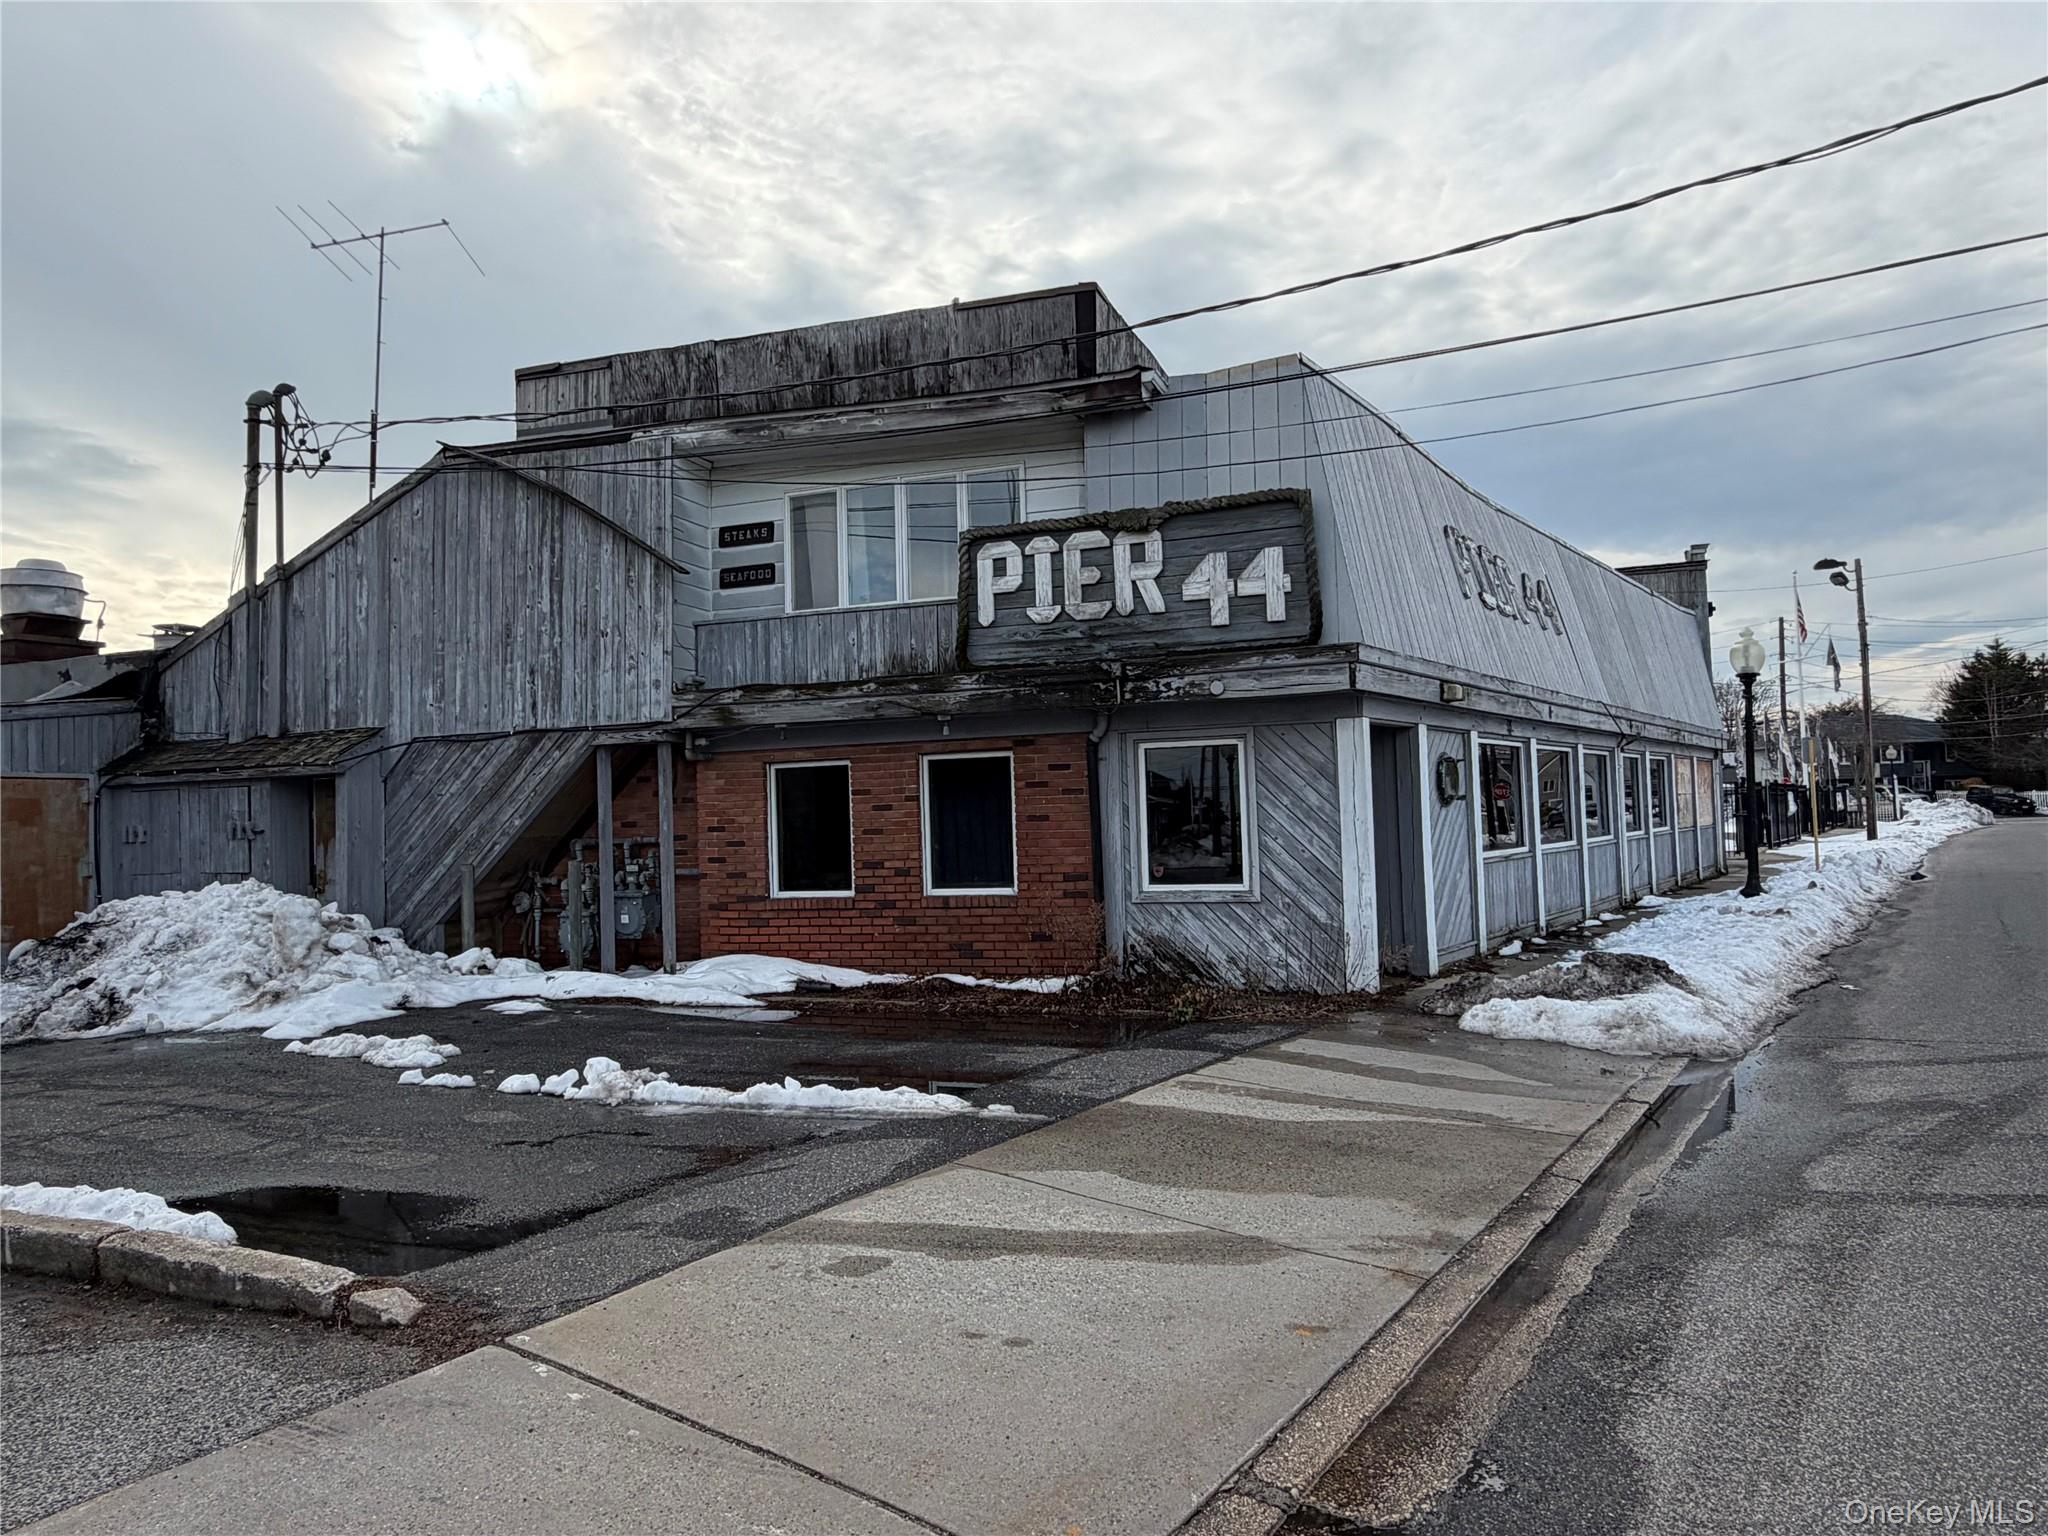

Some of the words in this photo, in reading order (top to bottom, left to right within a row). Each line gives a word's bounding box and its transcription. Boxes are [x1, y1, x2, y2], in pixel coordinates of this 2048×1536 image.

[724, 527, 768, 542] STEAKS
[722, 568, 772, 583] SEAFOOD
[976, 530, 1166, 628] PIER
[1182, 546, 1292, 627] 44
[1521, 572, 1563, 637] 44
